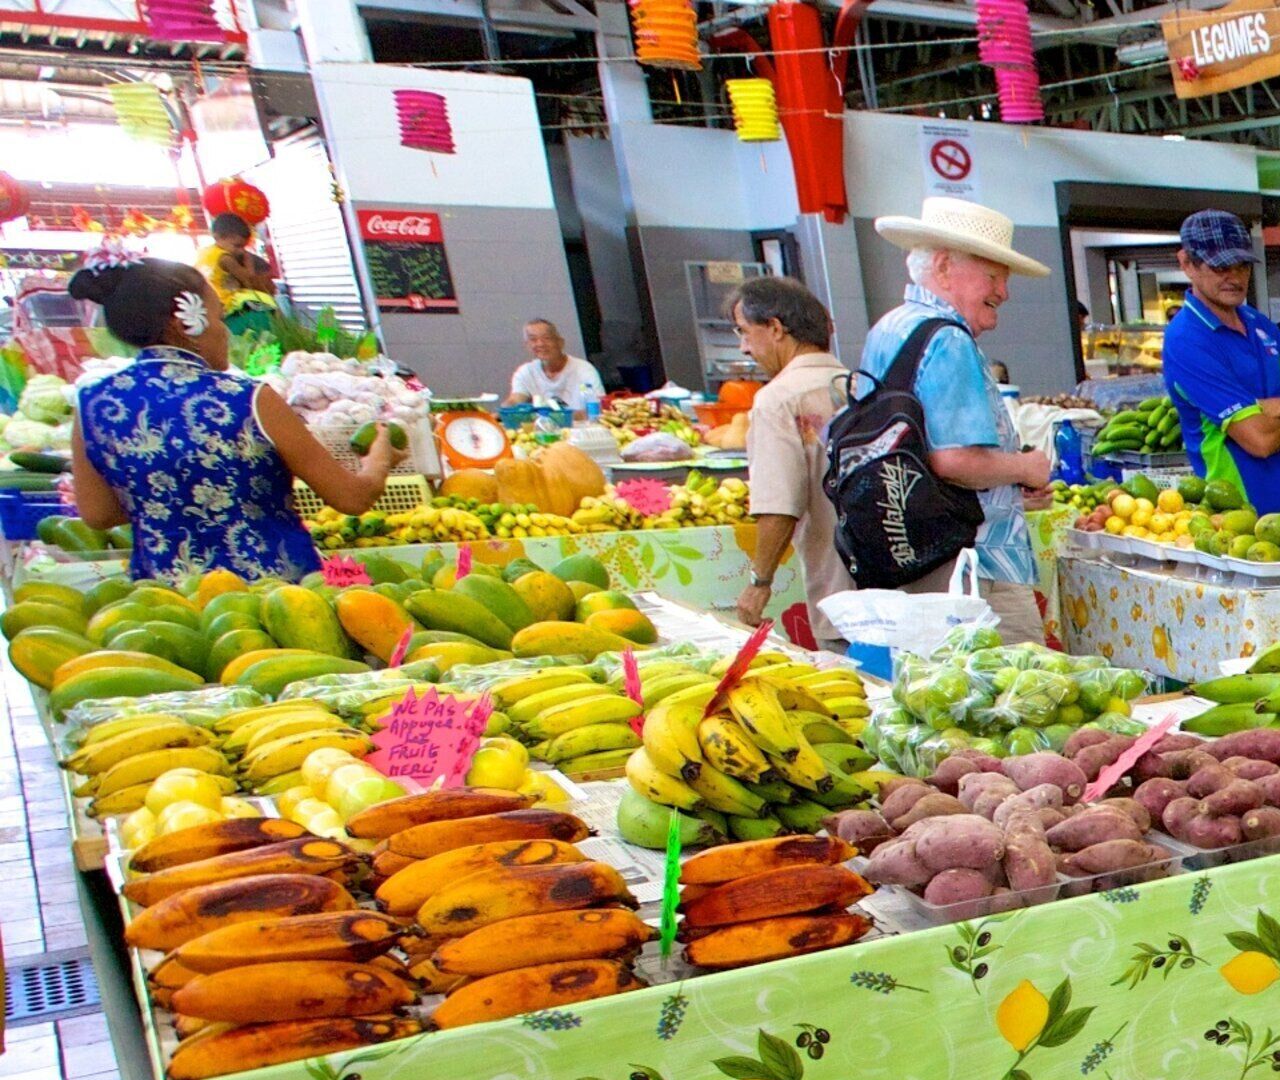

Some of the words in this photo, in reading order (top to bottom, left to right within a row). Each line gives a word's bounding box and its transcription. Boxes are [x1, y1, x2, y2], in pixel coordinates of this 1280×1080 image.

[1190, 12, 1271, 66] LEGUMES
[367, 214, 432, 236] Coca-Cola
[876, 455, 921, 568] Billabong
[393, 699, 419, 717] NE
